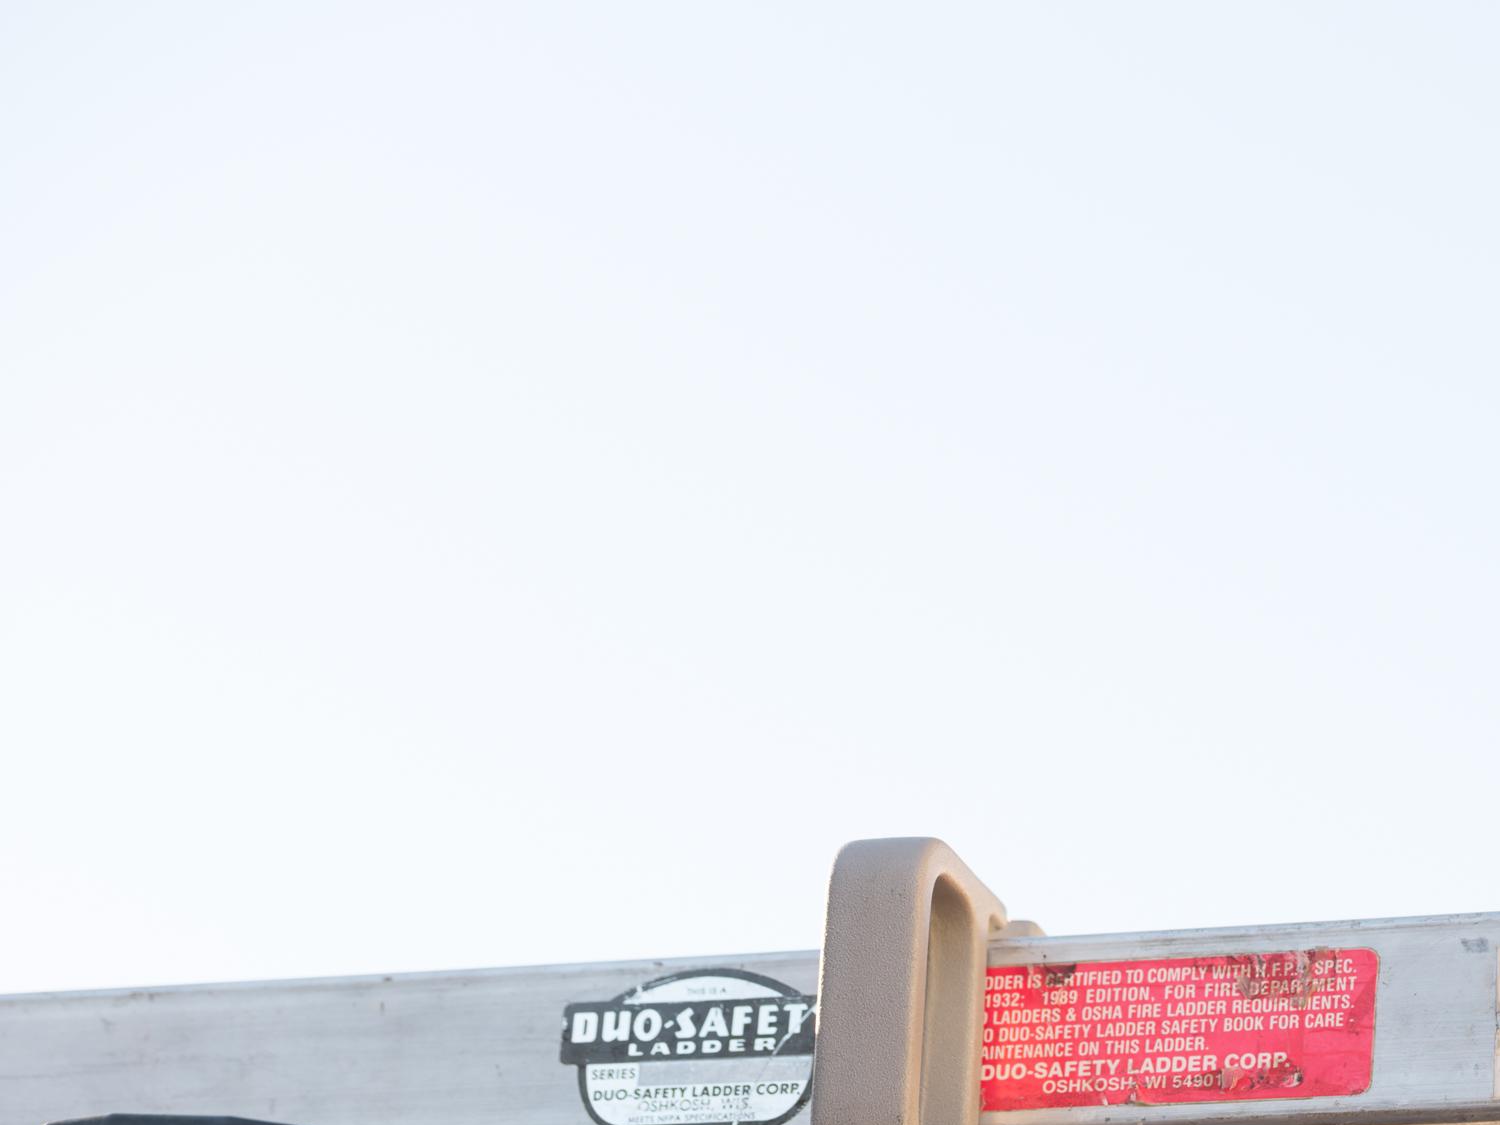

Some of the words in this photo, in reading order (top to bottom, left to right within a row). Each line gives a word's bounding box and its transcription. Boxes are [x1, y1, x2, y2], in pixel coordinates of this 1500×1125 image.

[1027, 973, 1042, 989] IS
[1046, 970, 1121, 988] CERTIFIED
[1126, 969, 1144, 984] TO
[1147, 965, 1206, 983] COMPLY
[1211, 963, 1252, 980] WITH
[1314, 958, 1357, 976] SPEC.
[1042, 989, 1078, 1005] 1989
[1086, 987, 1155, 1004] EDITION,
[1164, 984, 1195, 1000] FOR
[1204, 982, 1240, 998] FIRE
[1249, 976, 1358, 996] DEPARMENT
[570, 1003, 809, 1044] DUO-SAFET
[992, 1008, 1061, 1025] LADDERS
[1065, 1007, 1076, 1021] &
[1082, 1005, 1122, 1021] OSHA
[1128, 1004, 1161, 1019] FIRE
[1167, 1000, 1226, 1017] LADDER
[999, 1024, 1091, 1042] DUO-SAFETY
[1096, 1022, 1155, 1038] LADDER
[1161, 1018, 1218, 1035] SAFETY
[1223, 1015, 1265, 1032] BOOK
[1269, 1014, 1299, 1030] FOR
[1304, 1012, 1344, 1028] CARE
[627, 1036, 777, 1057] LADDER
[982, 1042, 1073, 1060] AINTENANCE
[1078, 1042, 1099, 1057] ON
[1105, 1040, 1140, 1055] THIS
[1145, 1036, 1209, 1054] LADDER.
[591, 1068, 635, 1081] SERIES
[981, 1059, 1120, 1081] DUO-SAFETY
[1127, 1054, 1218, 1075] LADDER
[1224, 1051, 1291, 1070] CORP.
[593, 1086, 688, 1102] DUO-SAFETY
[692, 1084, 751, 1098] LADDER
[756, 1082, 801, 1097] CORP.
[1145, 1074, 1167, 1089] WI
